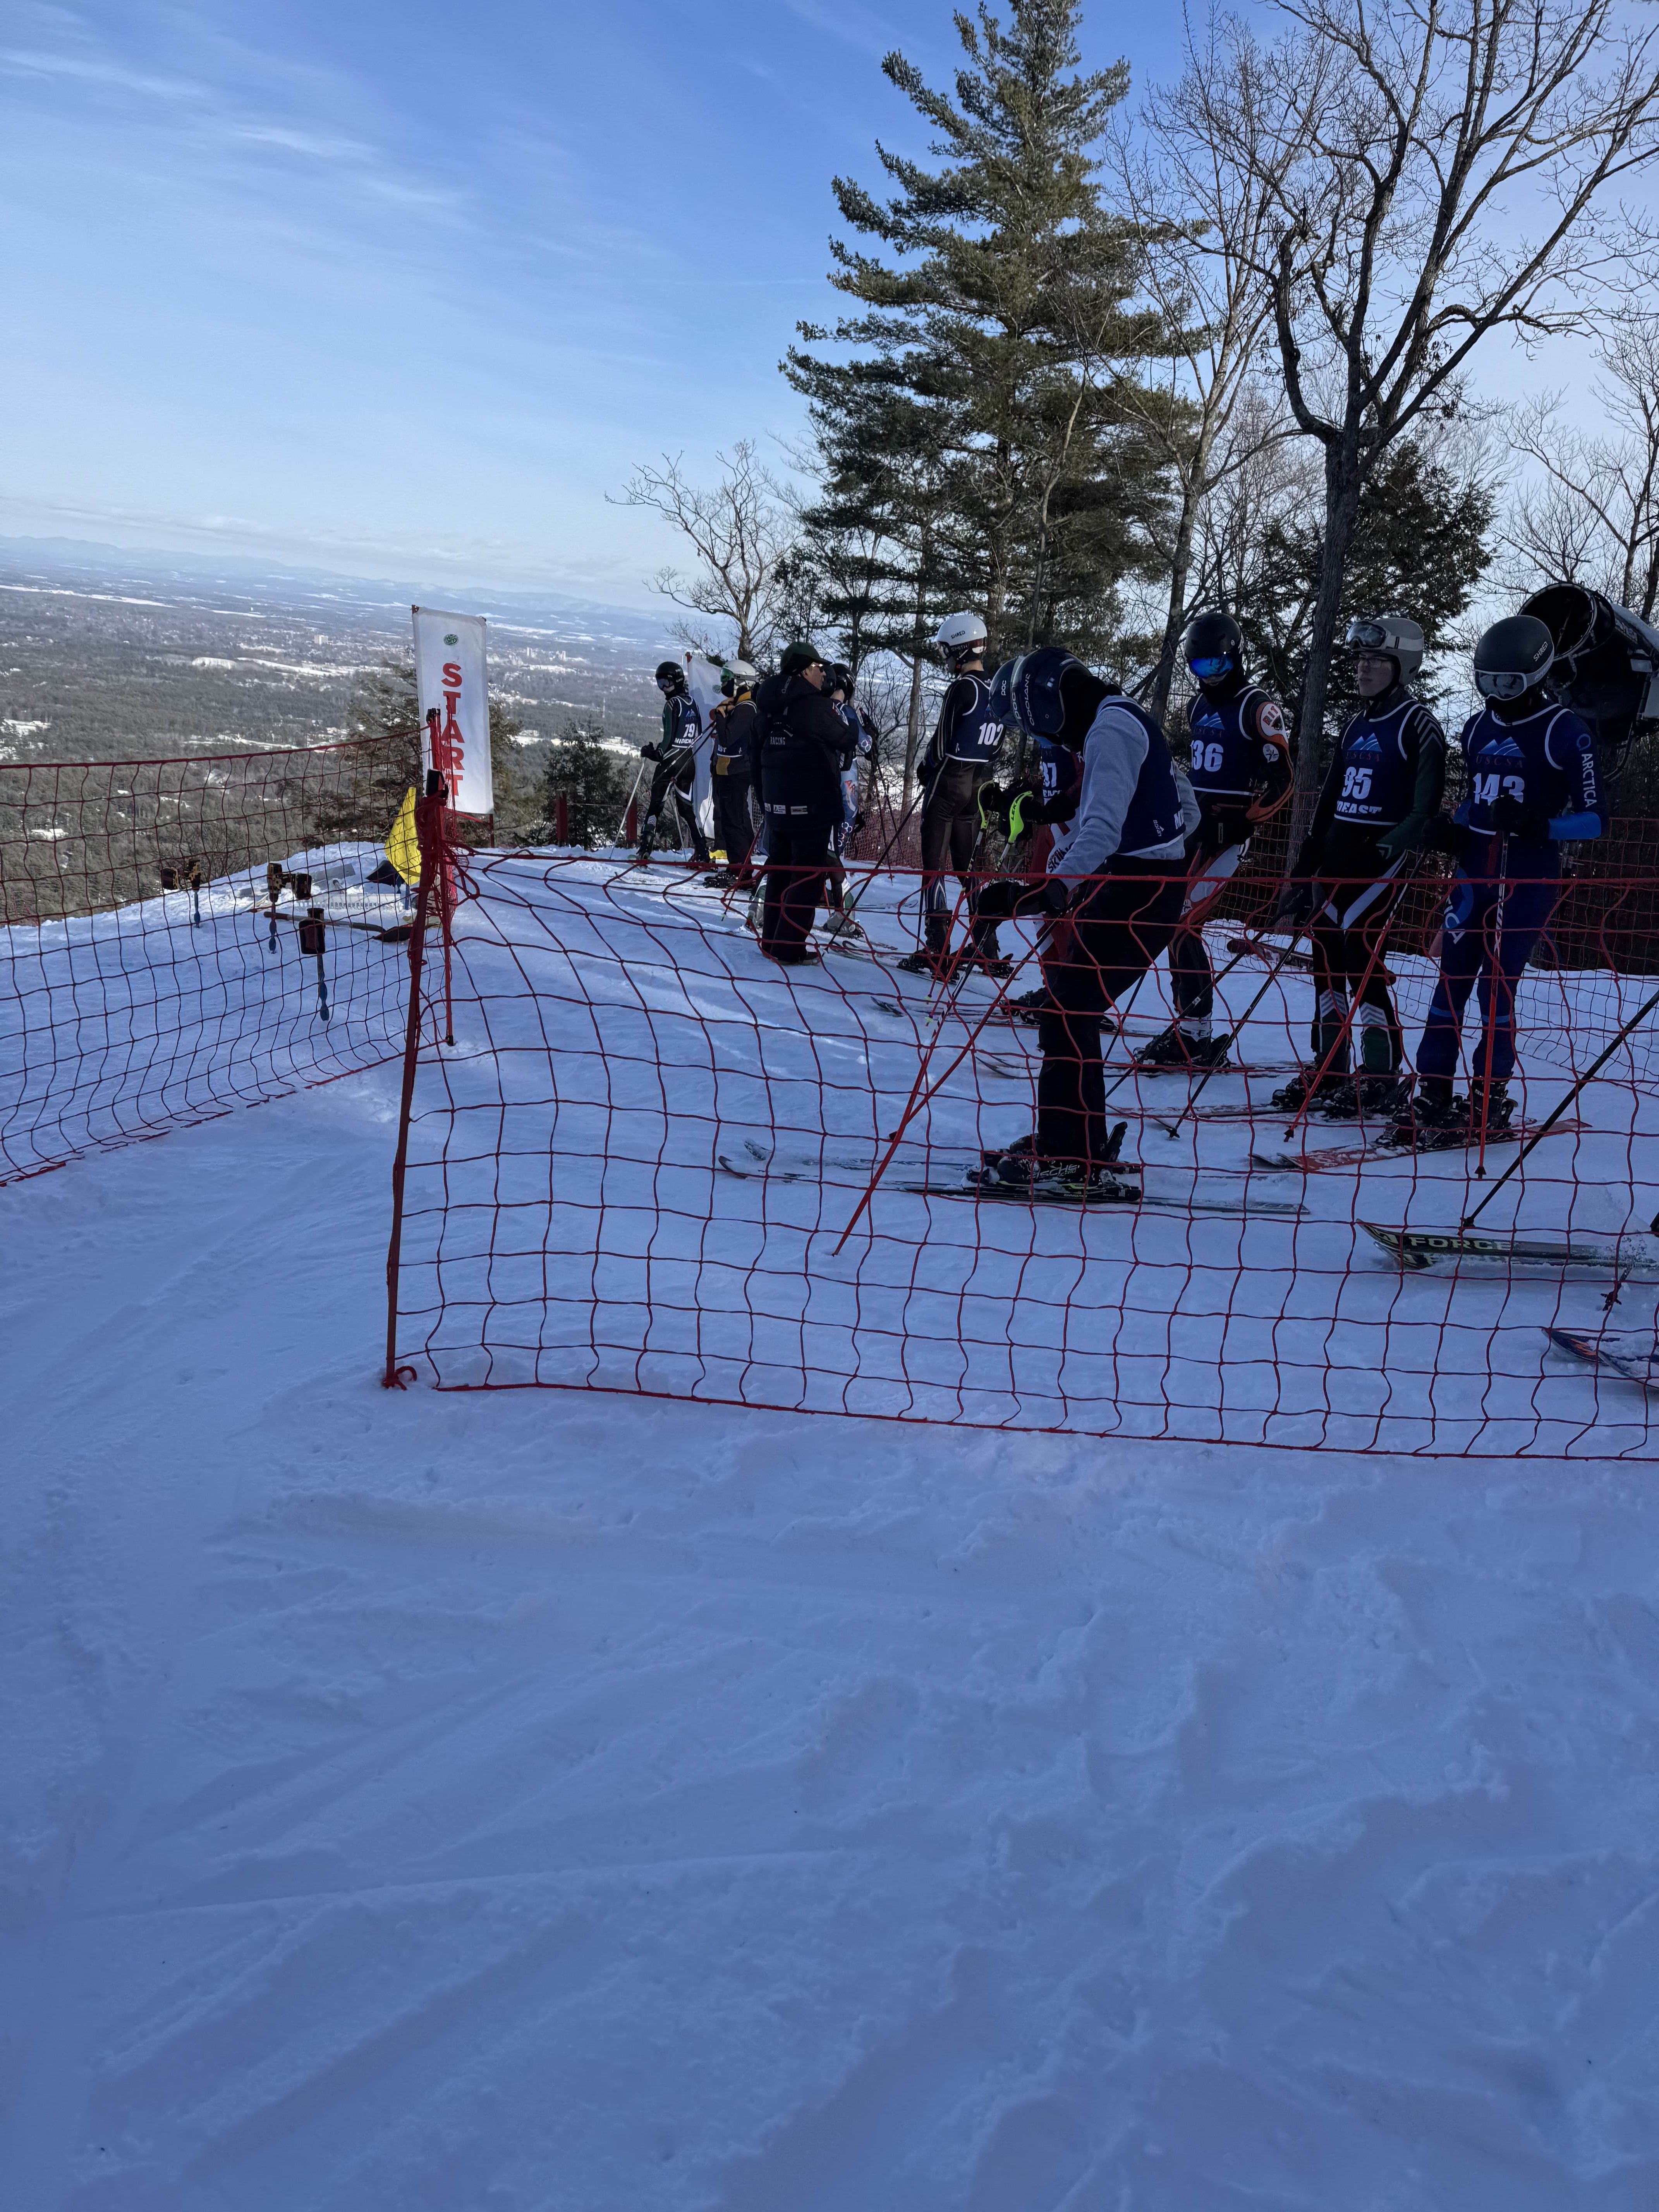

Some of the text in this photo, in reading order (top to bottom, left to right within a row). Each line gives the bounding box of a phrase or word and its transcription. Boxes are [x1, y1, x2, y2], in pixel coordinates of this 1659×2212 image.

[951, 630, 965, 639] SHRED
[1533, 641, 1548, 662] SHRED
[441, 663, 465, 796] START
[683, 723, 696, 738] 79
[977, 722, 1004, 746] 102
[769, 736, 786, 745] RACING
[1472, 773, 1525, 806] 143
[1581, 753, 1597, 808] ARCTICA
[1408, 1236, 1512, 1251] FORCE
